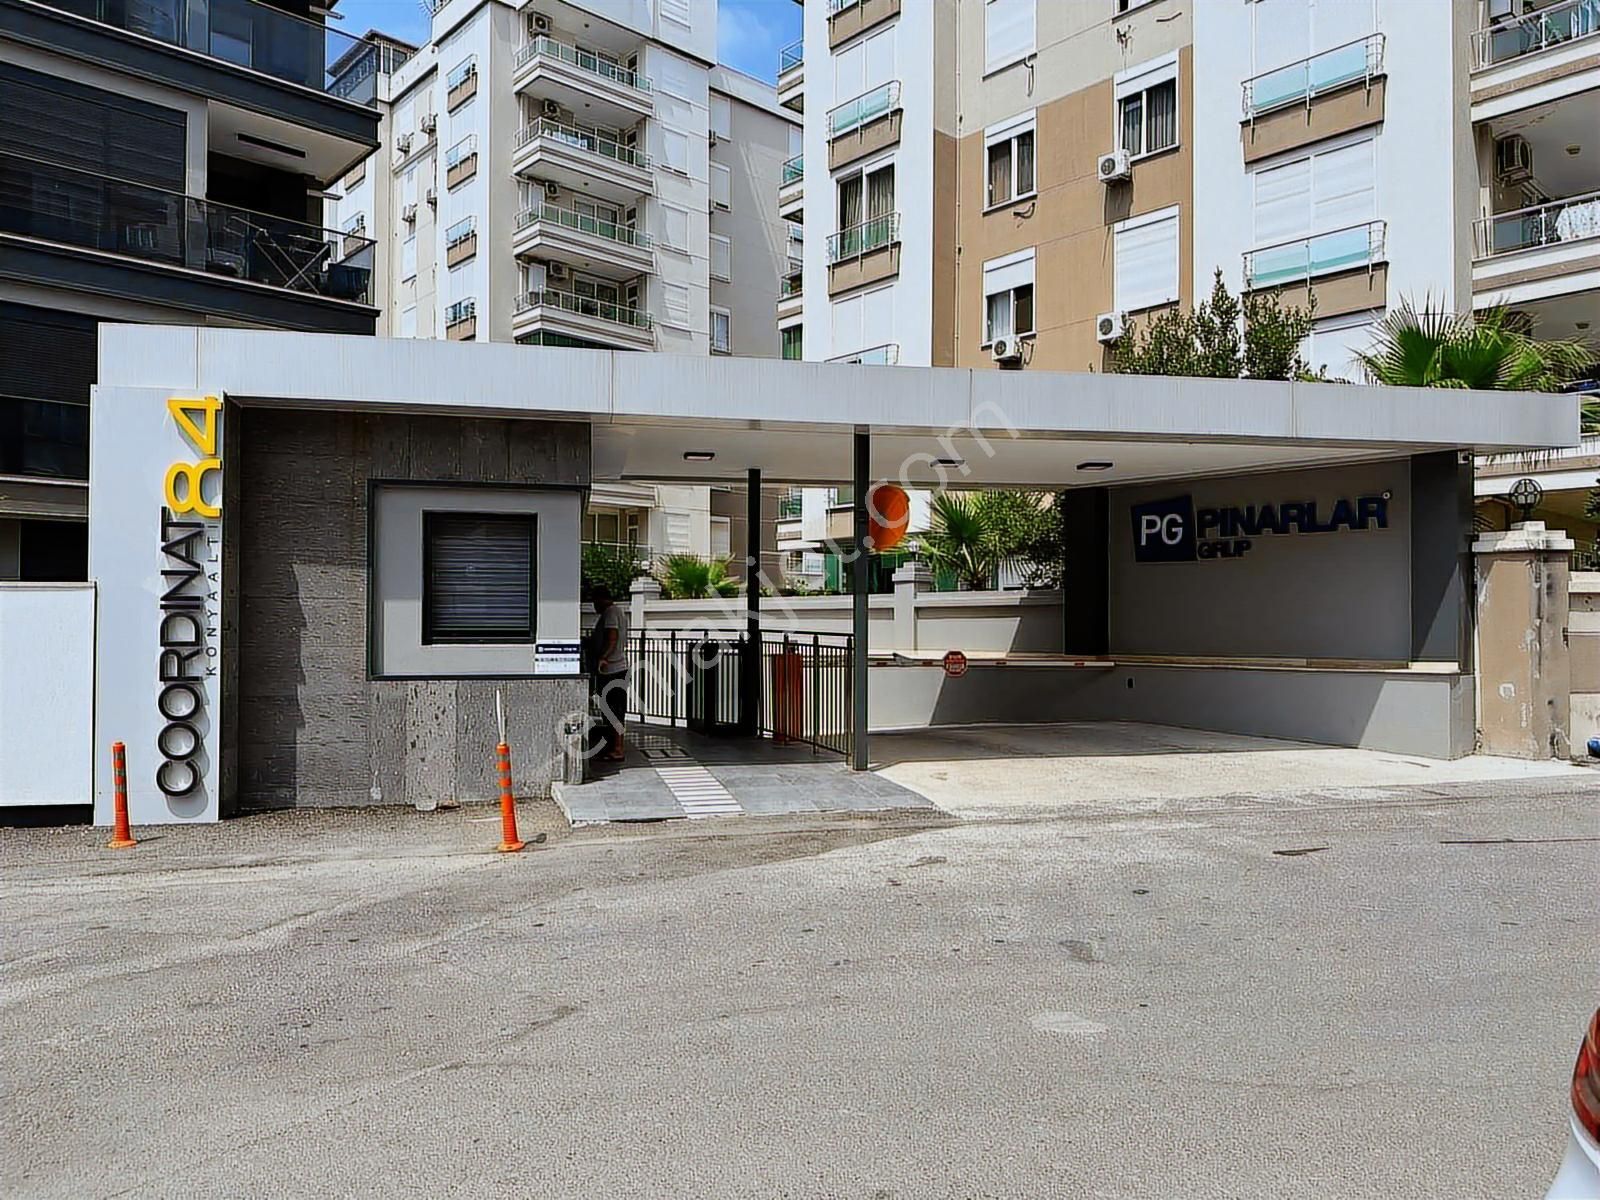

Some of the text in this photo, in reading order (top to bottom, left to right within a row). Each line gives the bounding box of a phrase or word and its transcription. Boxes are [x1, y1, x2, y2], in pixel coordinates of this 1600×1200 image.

[1140, 513, 1184, 546] PG
[1196, 496, 1389, 538] PINARLAR
[1198, 540, 1252, 559] GRUP
[156, 396, 224, 797] COORDINAT 84
[205, 525, 219, 676] KONYAALTI
